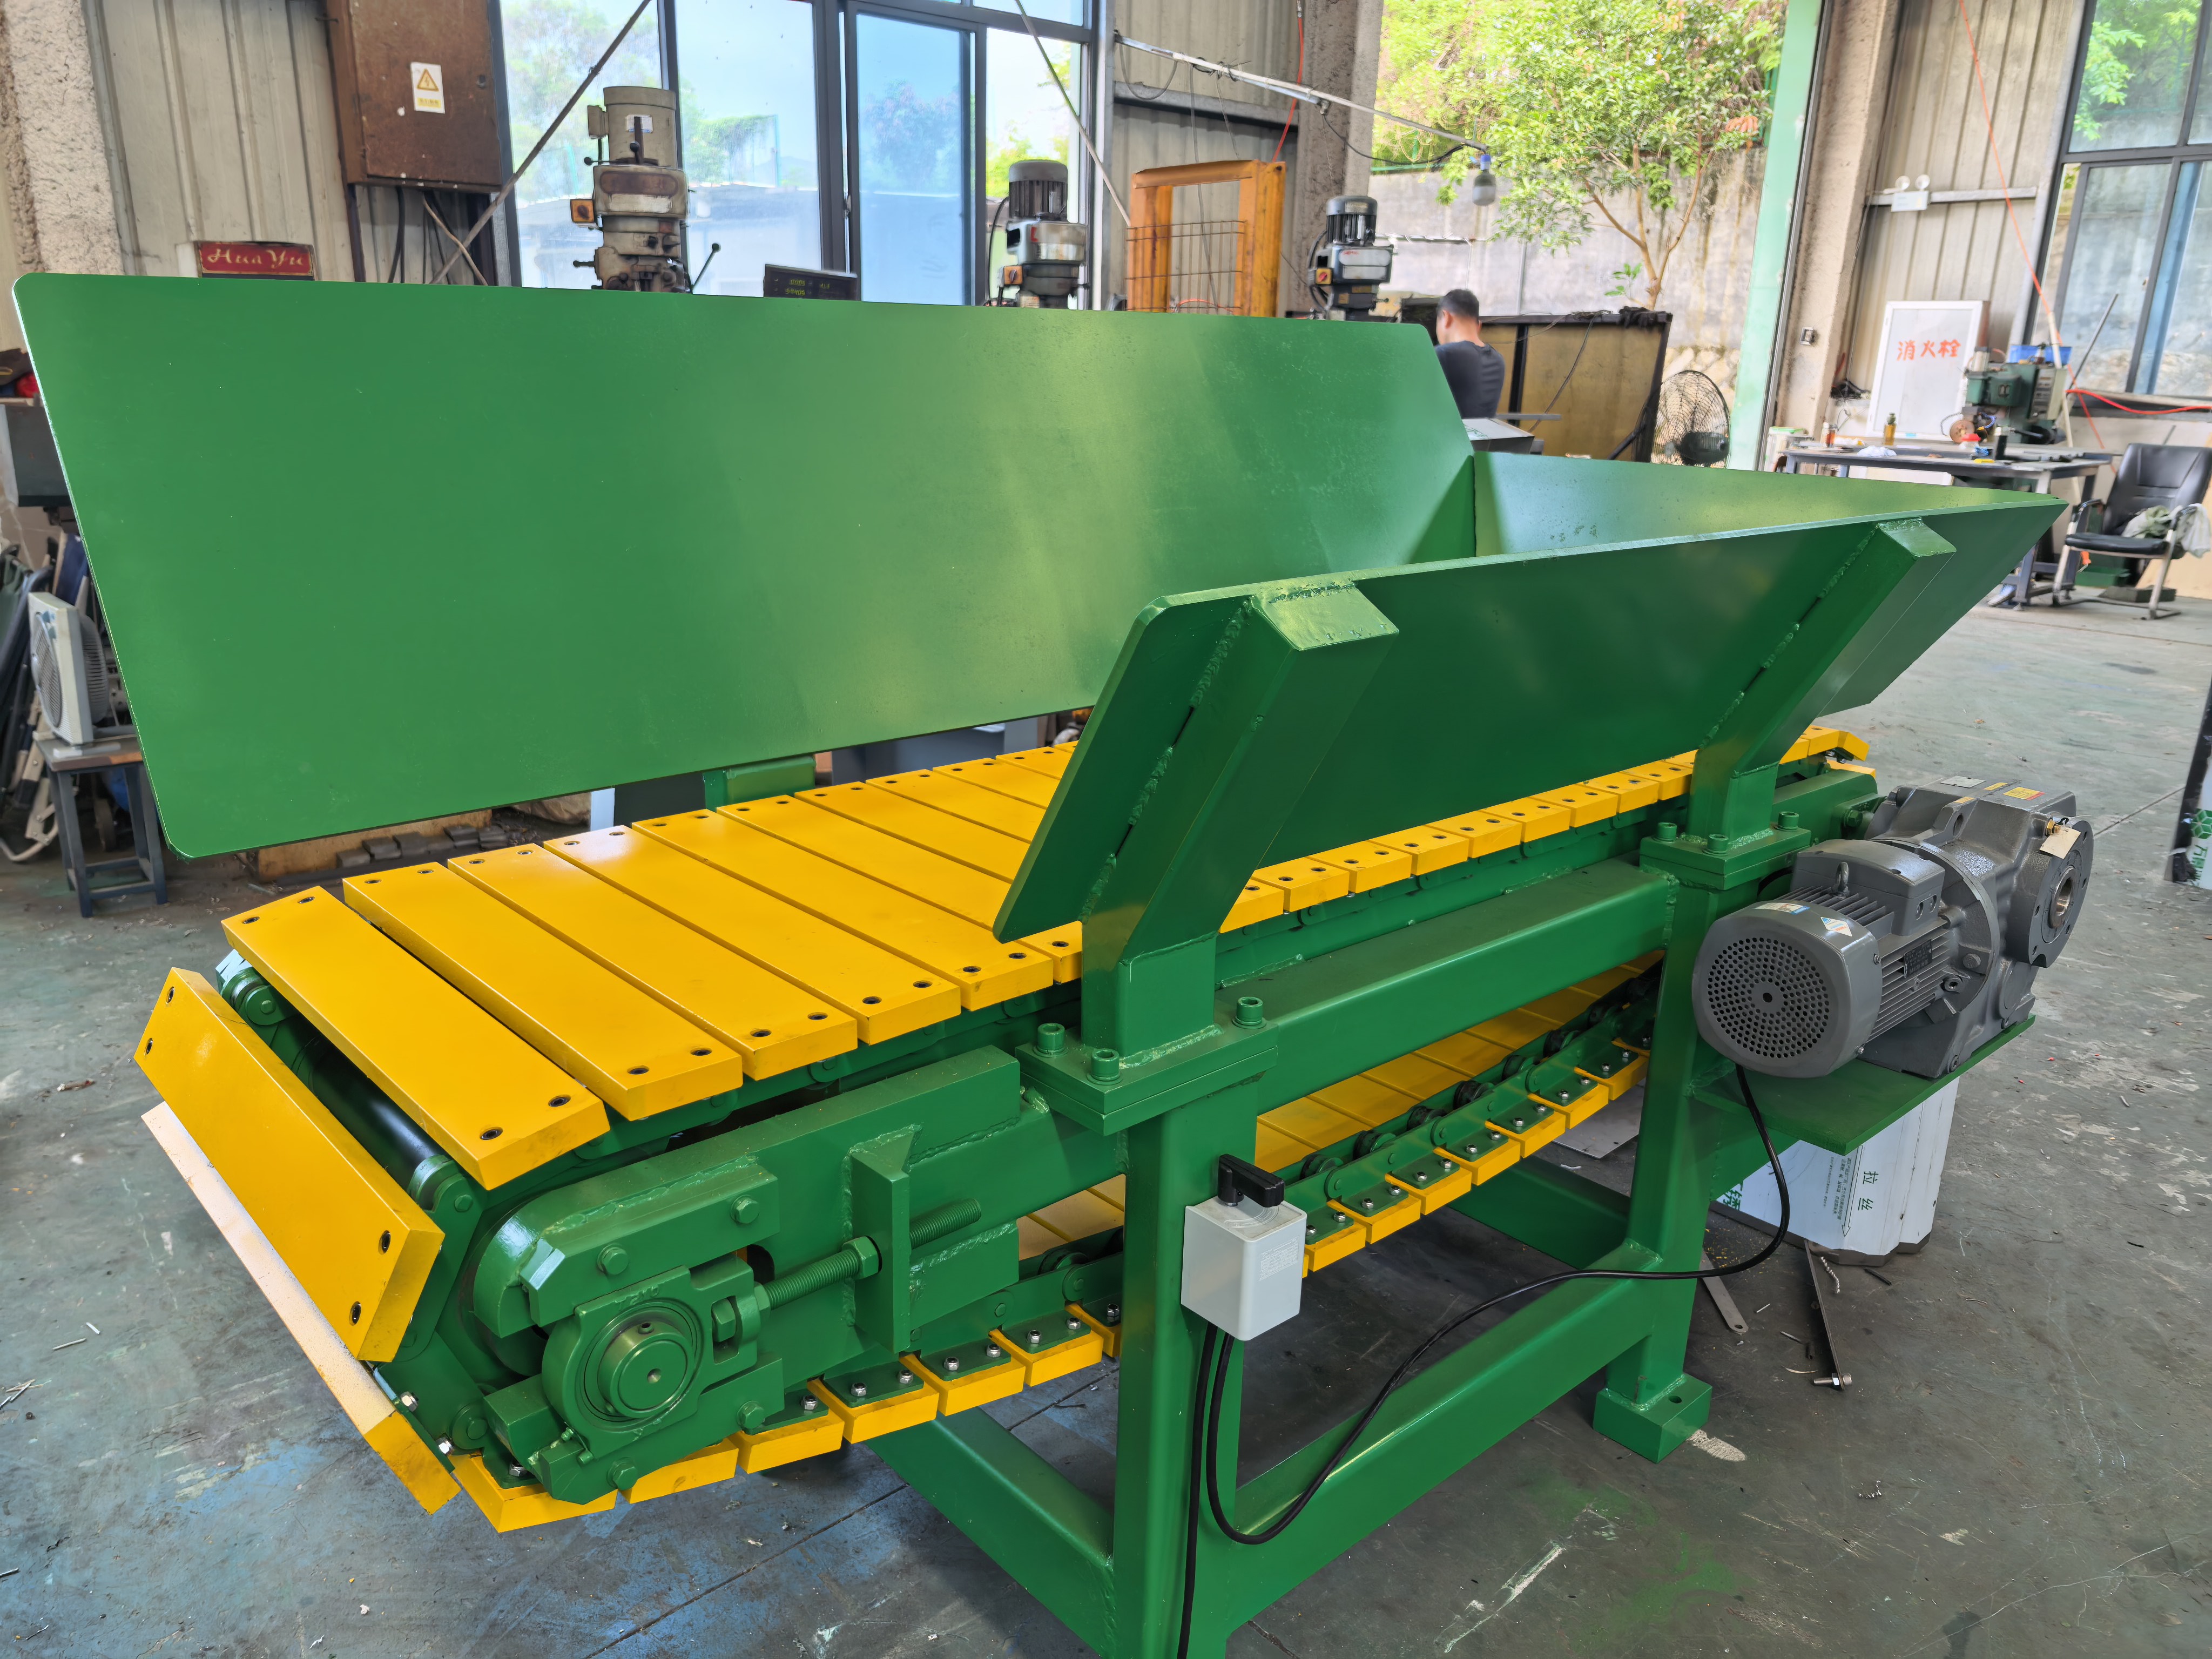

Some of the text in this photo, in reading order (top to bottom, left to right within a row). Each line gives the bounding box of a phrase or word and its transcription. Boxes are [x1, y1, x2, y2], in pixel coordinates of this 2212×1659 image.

[207, 248, 262, 264] Hua
[1896, 339, 1961, 361] 消火栓
